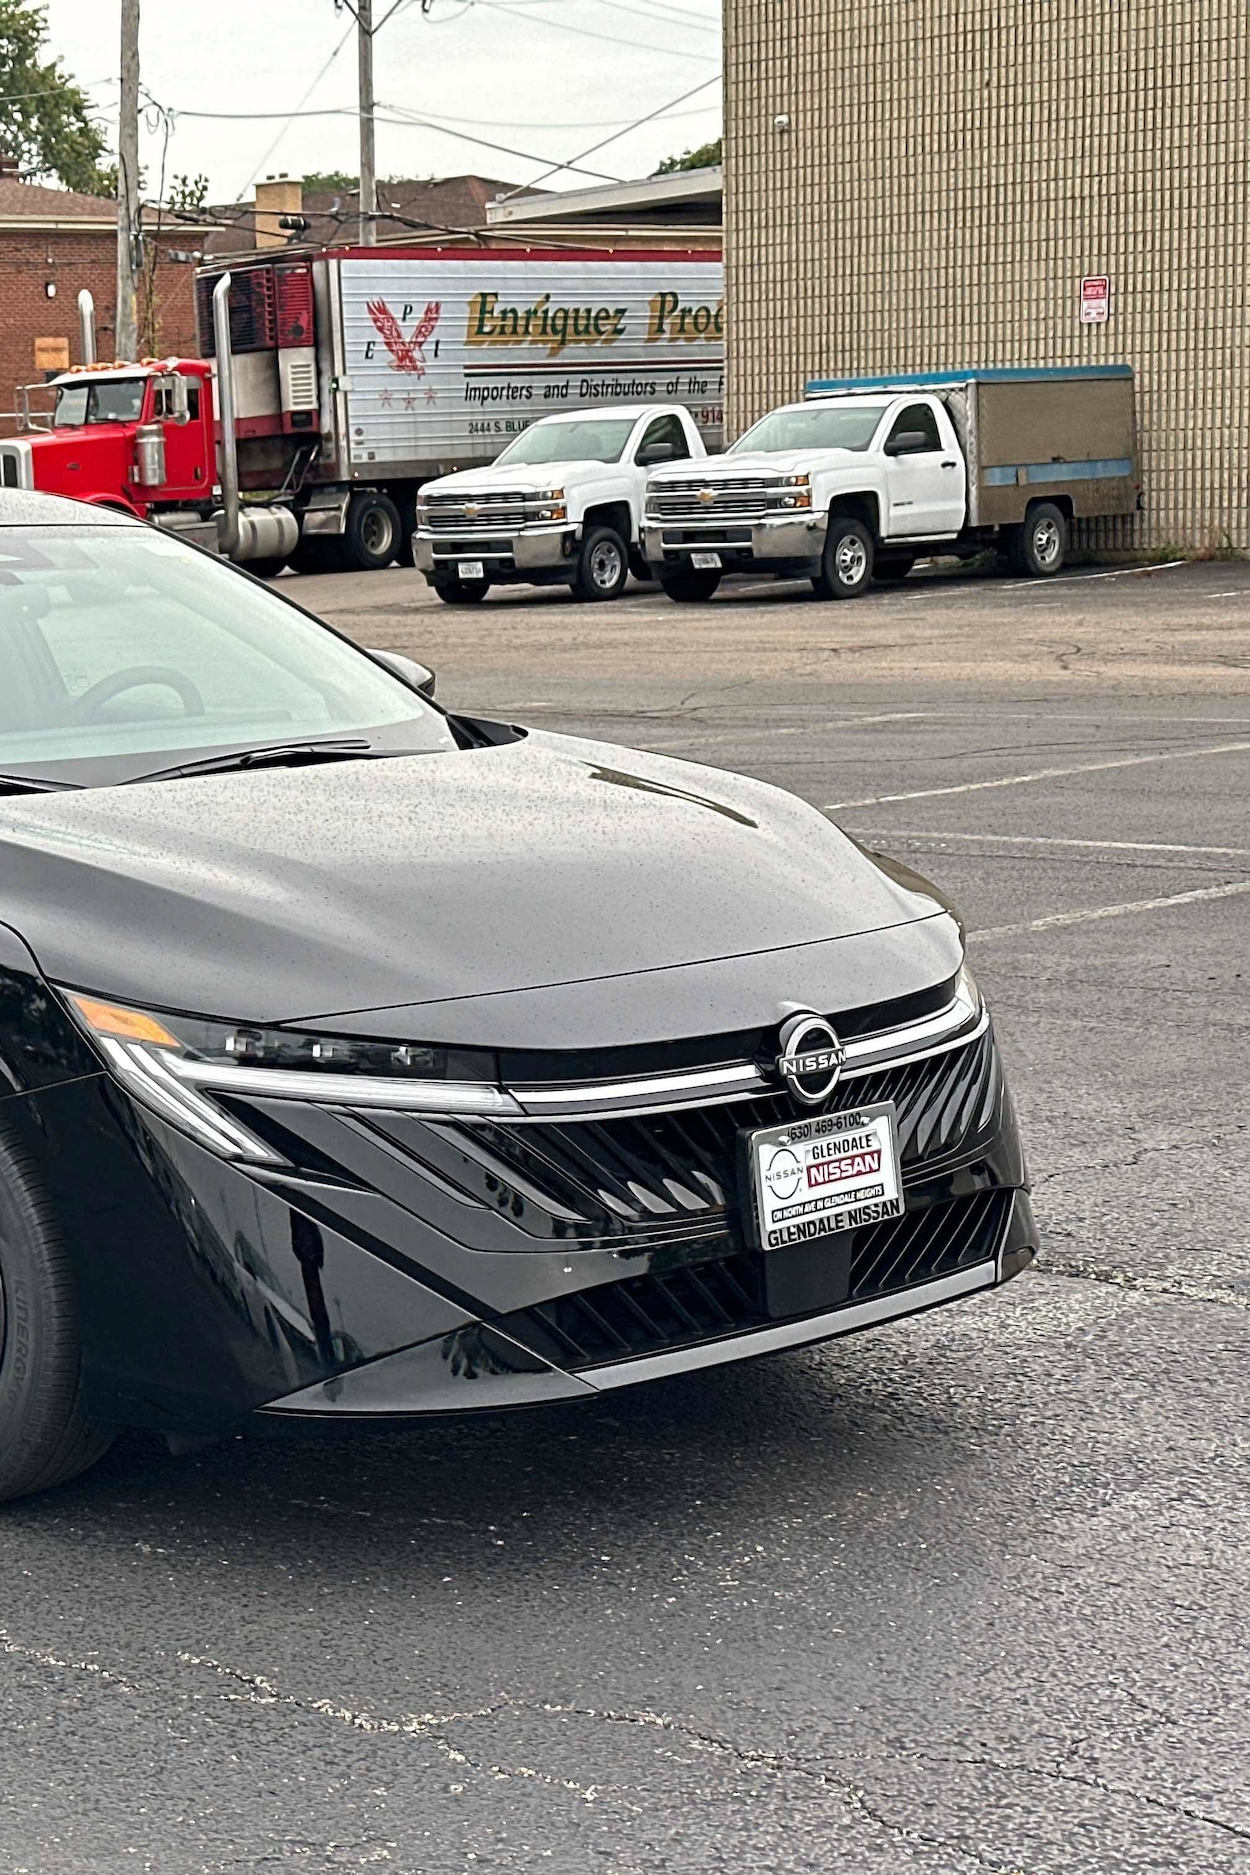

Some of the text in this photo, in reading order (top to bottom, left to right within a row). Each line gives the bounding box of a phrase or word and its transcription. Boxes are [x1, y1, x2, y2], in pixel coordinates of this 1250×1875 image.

[402, 304, 413, 321] P
[365, 341, 376, 359] E
[464, 382, 533, 406] Importers
[543, 379, 569, 399] and
[579, 378, 657, 397] Distributors
[667, 376, 680, 395] of
[688, 375, 708, 394] the
[468, 421, 491, 434] 2444
[783, 1049, 846, 1074] NISSAN
[788, 1112, 861, 1140] (630) 469-6100
[812, 1134, 872, 1160] GLENDALE
[765, 1165, 804, 1183] NISSAN
[810, 1153, 879, 1185] NISSAN
[773, 1186, 883, 1221] ON NORTH AVE IN GLENDALE HEIGHTS
[768, 1200, 900, 1247] GLENDALE NISSAN
